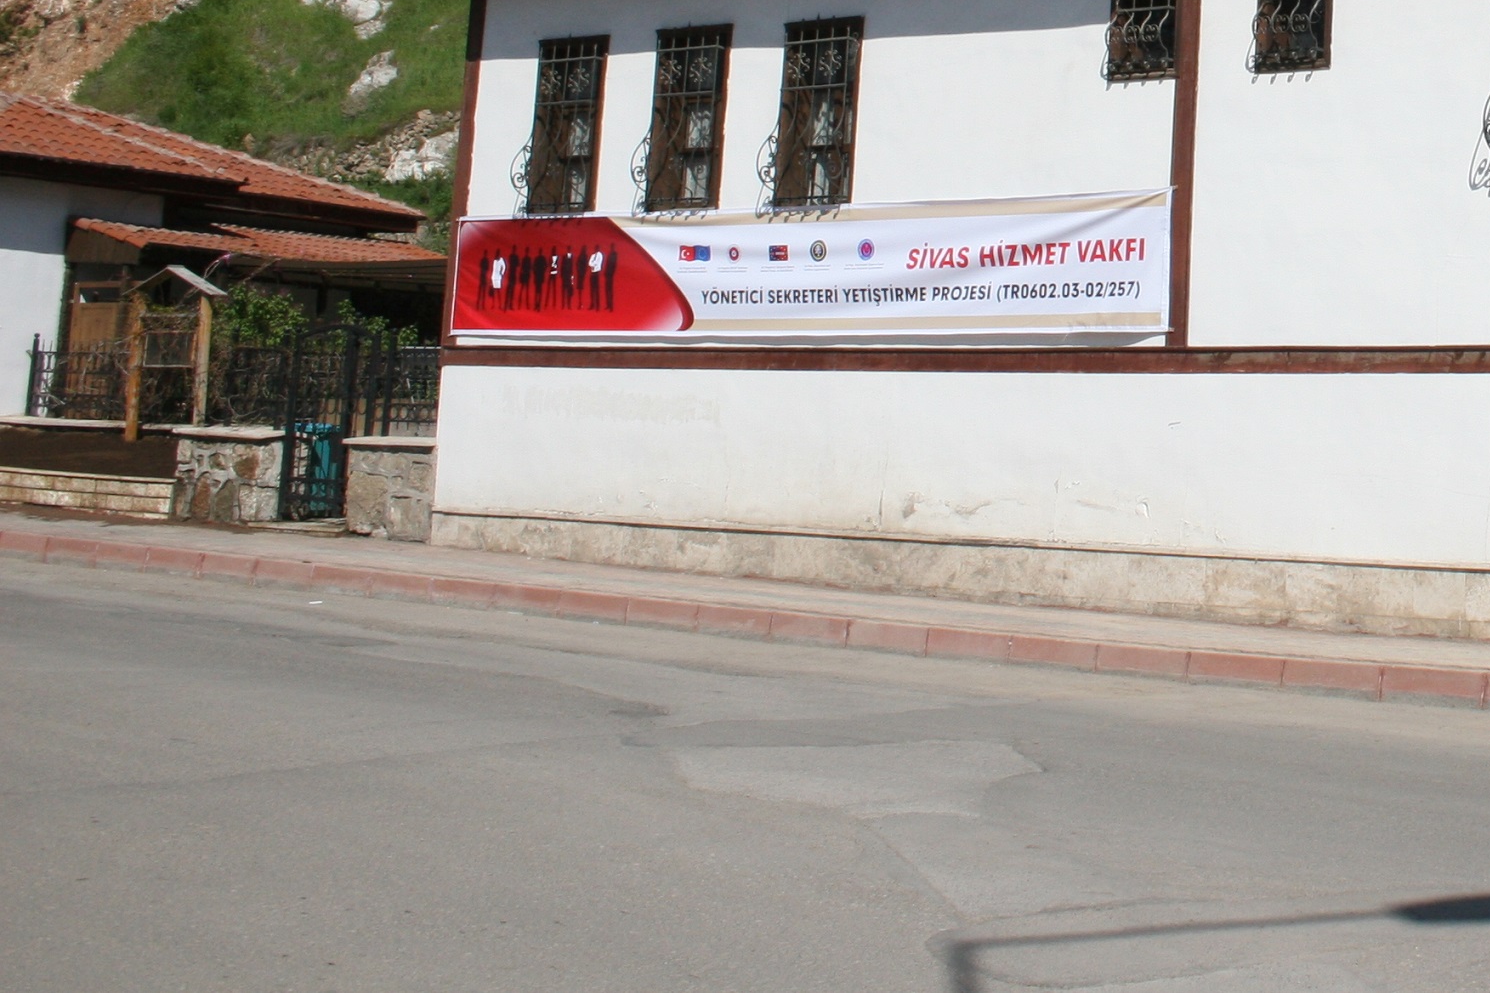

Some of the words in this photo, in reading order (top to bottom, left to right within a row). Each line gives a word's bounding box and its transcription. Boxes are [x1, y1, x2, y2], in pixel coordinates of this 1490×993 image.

[906, 243, 970, 269] SİVAS
[979, 240, 1071, 267] HİZMET
[1077, 238, 1146, 262] VAKFI
[701, 286, 763, 304] YÖNETİCİ
[768, 285, 838, 304] SEKRETERİ
[843, 283, 927, 306] YETİŞTİRME
[932, 281, 992, 301] PROJESİ
[996, 280, 1141, 302] (TR0602.03-02/257)
